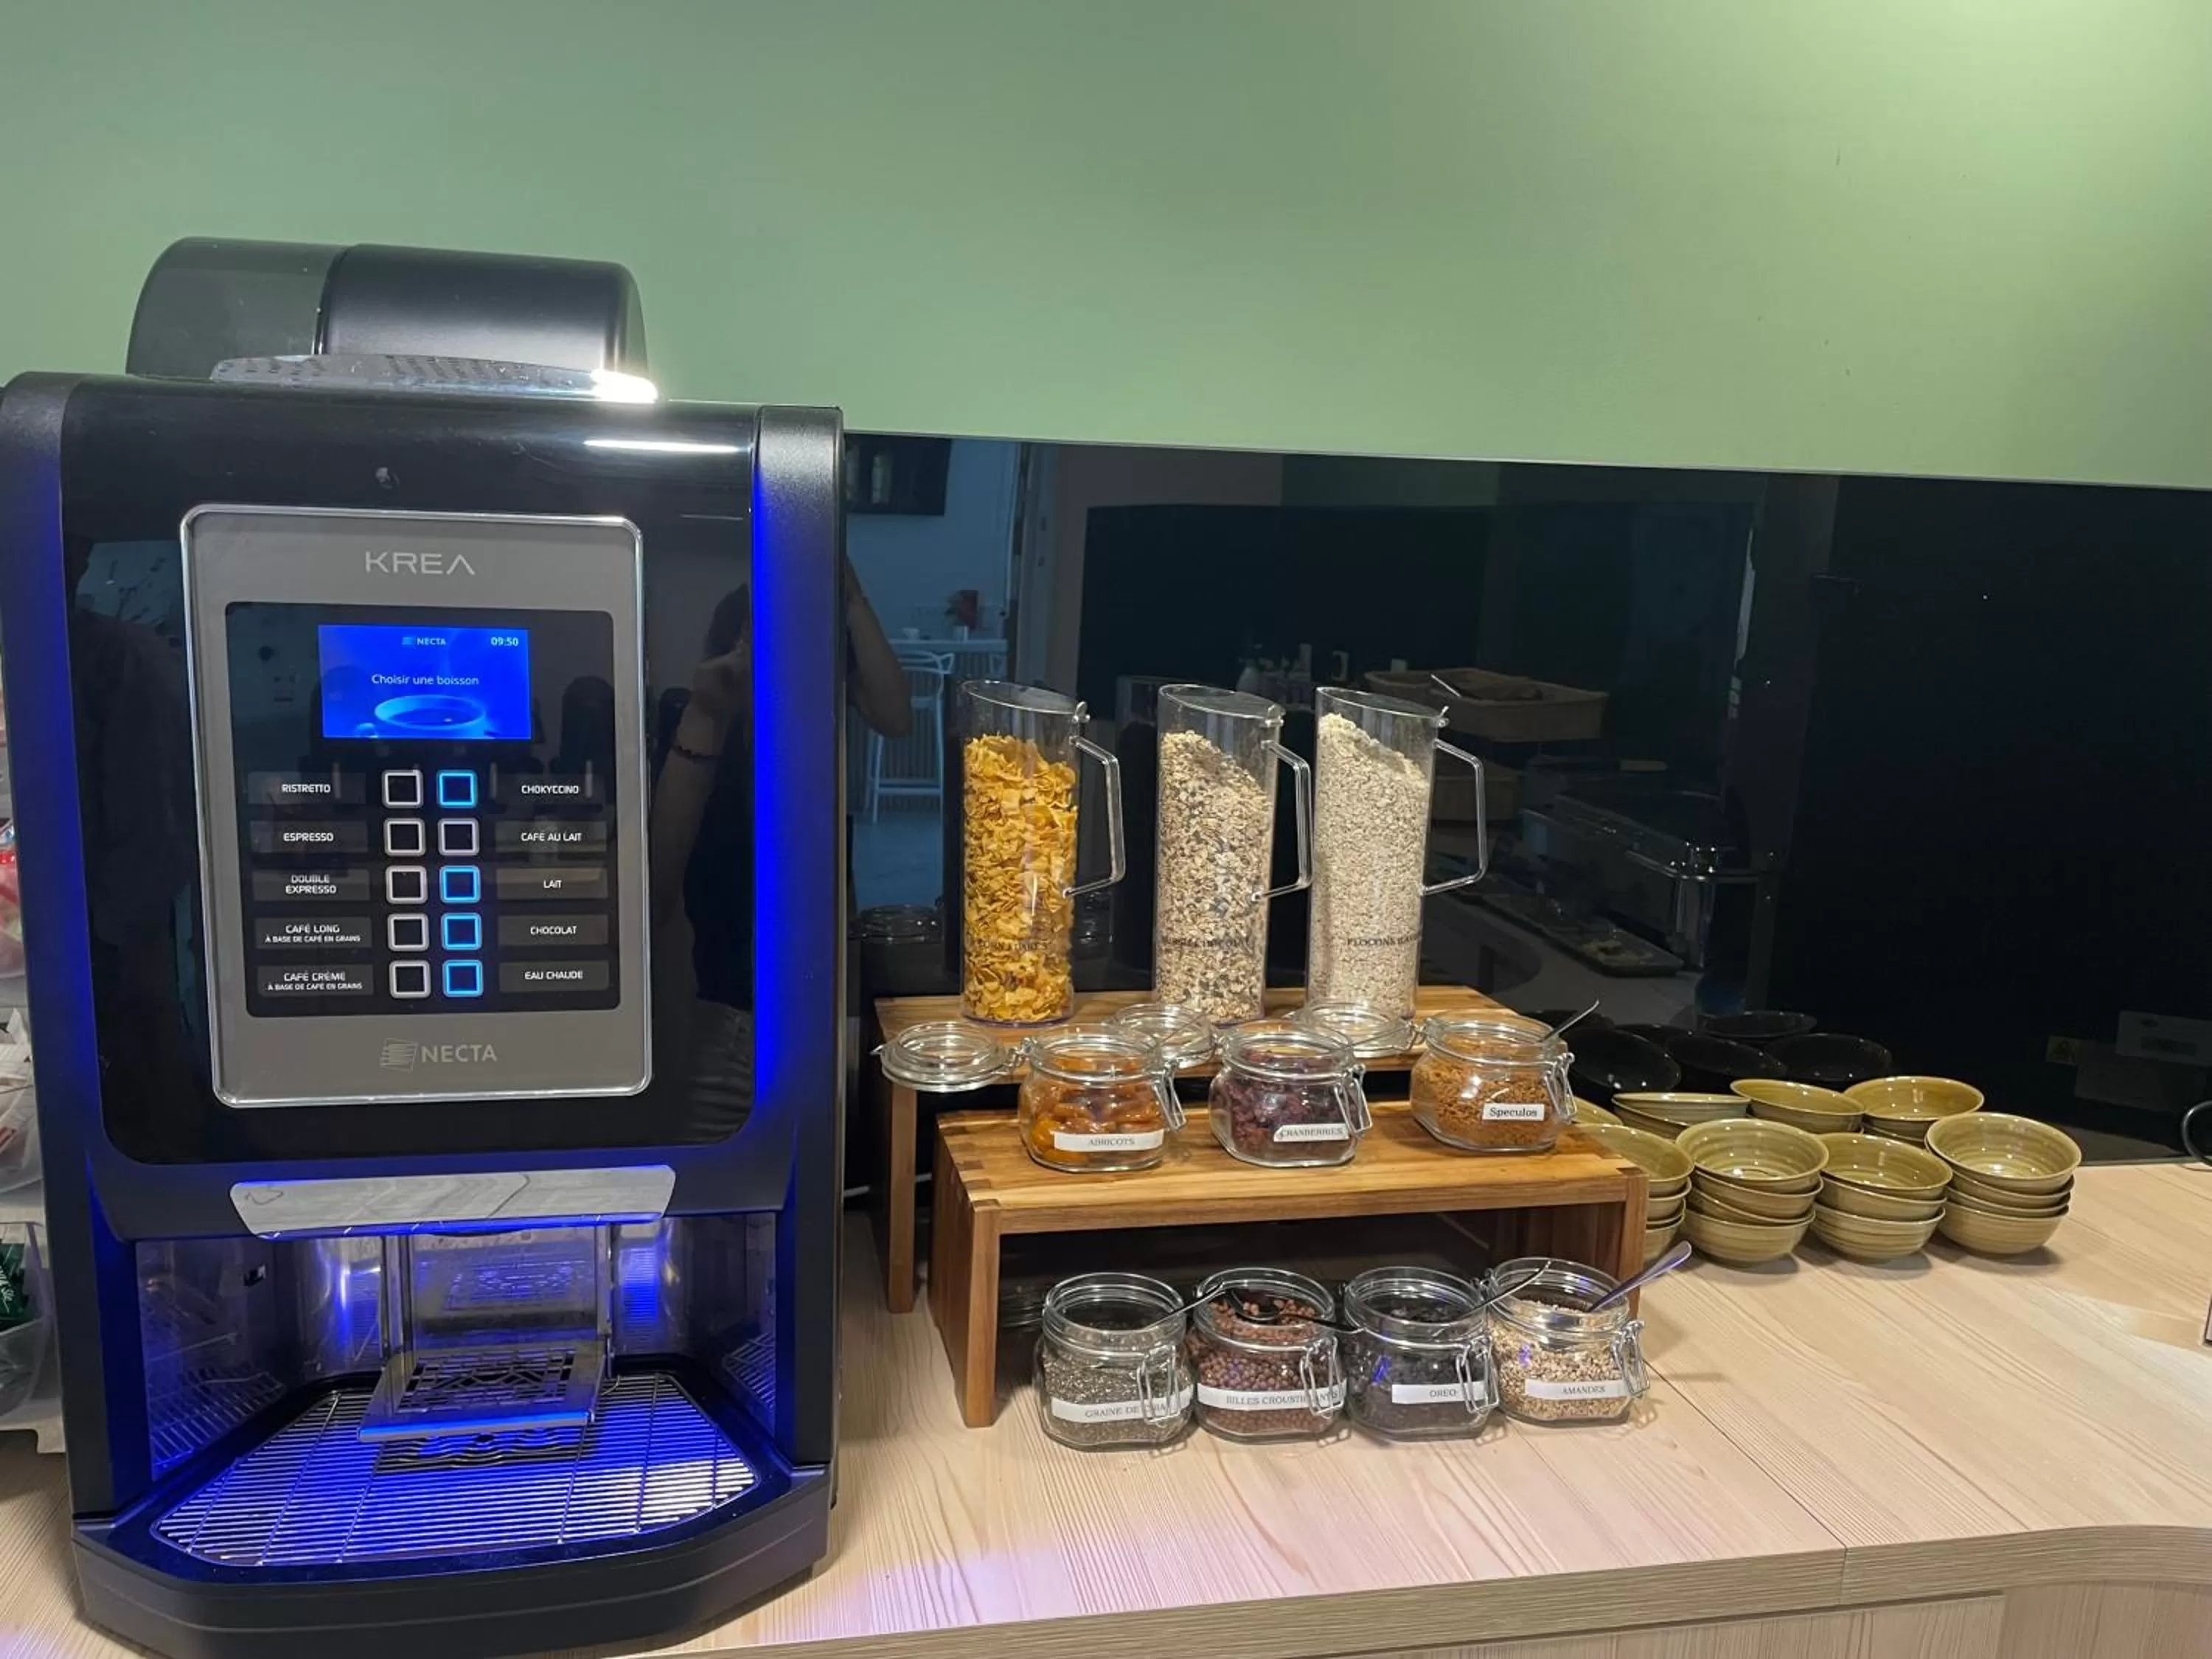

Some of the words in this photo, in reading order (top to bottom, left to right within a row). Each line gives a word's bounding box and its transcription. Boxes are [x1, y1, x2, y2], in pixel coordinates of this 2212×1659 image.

[364, 551, 476, 576] KREA
[416, 637, 447, 646] NECTA
[490, 636, 519, 647] 09:50
[371, 673, 410, 685] Choisir
[412, 676, 434, 685] une
[437, 675, 479, 686] boisson
[281, 783, 331, 793] RISTRETTO
[283, 832, 334, 842] ESPRESSO
[548, 832, 561, 841] AU
[563, 832, 582, 841] LAIT
[291, 874, 330, 883] DOUBLE
[285, 885, 337, 894] EXPRESSO
[543, 880, 563, 889] LAIT
[313, 924, 341, 933] LONG
[530, 925, 577, 936] CHOCOLAT
[524, 970, 543, 980] EAU
[546, 970, 583, 980] CHAUDE
[421, 1044, 498, 1062] NECTA
[1489, 1107, 1537, 1117] Speculos
[1089, 1138, 1135, 1146] ABRICOTS
[1429, 1388, 1457, 1398] OREO
[1562, 1386, 1605, 1394] AMANDES
[1085, 1407, 1121, 1416] GRAINE
